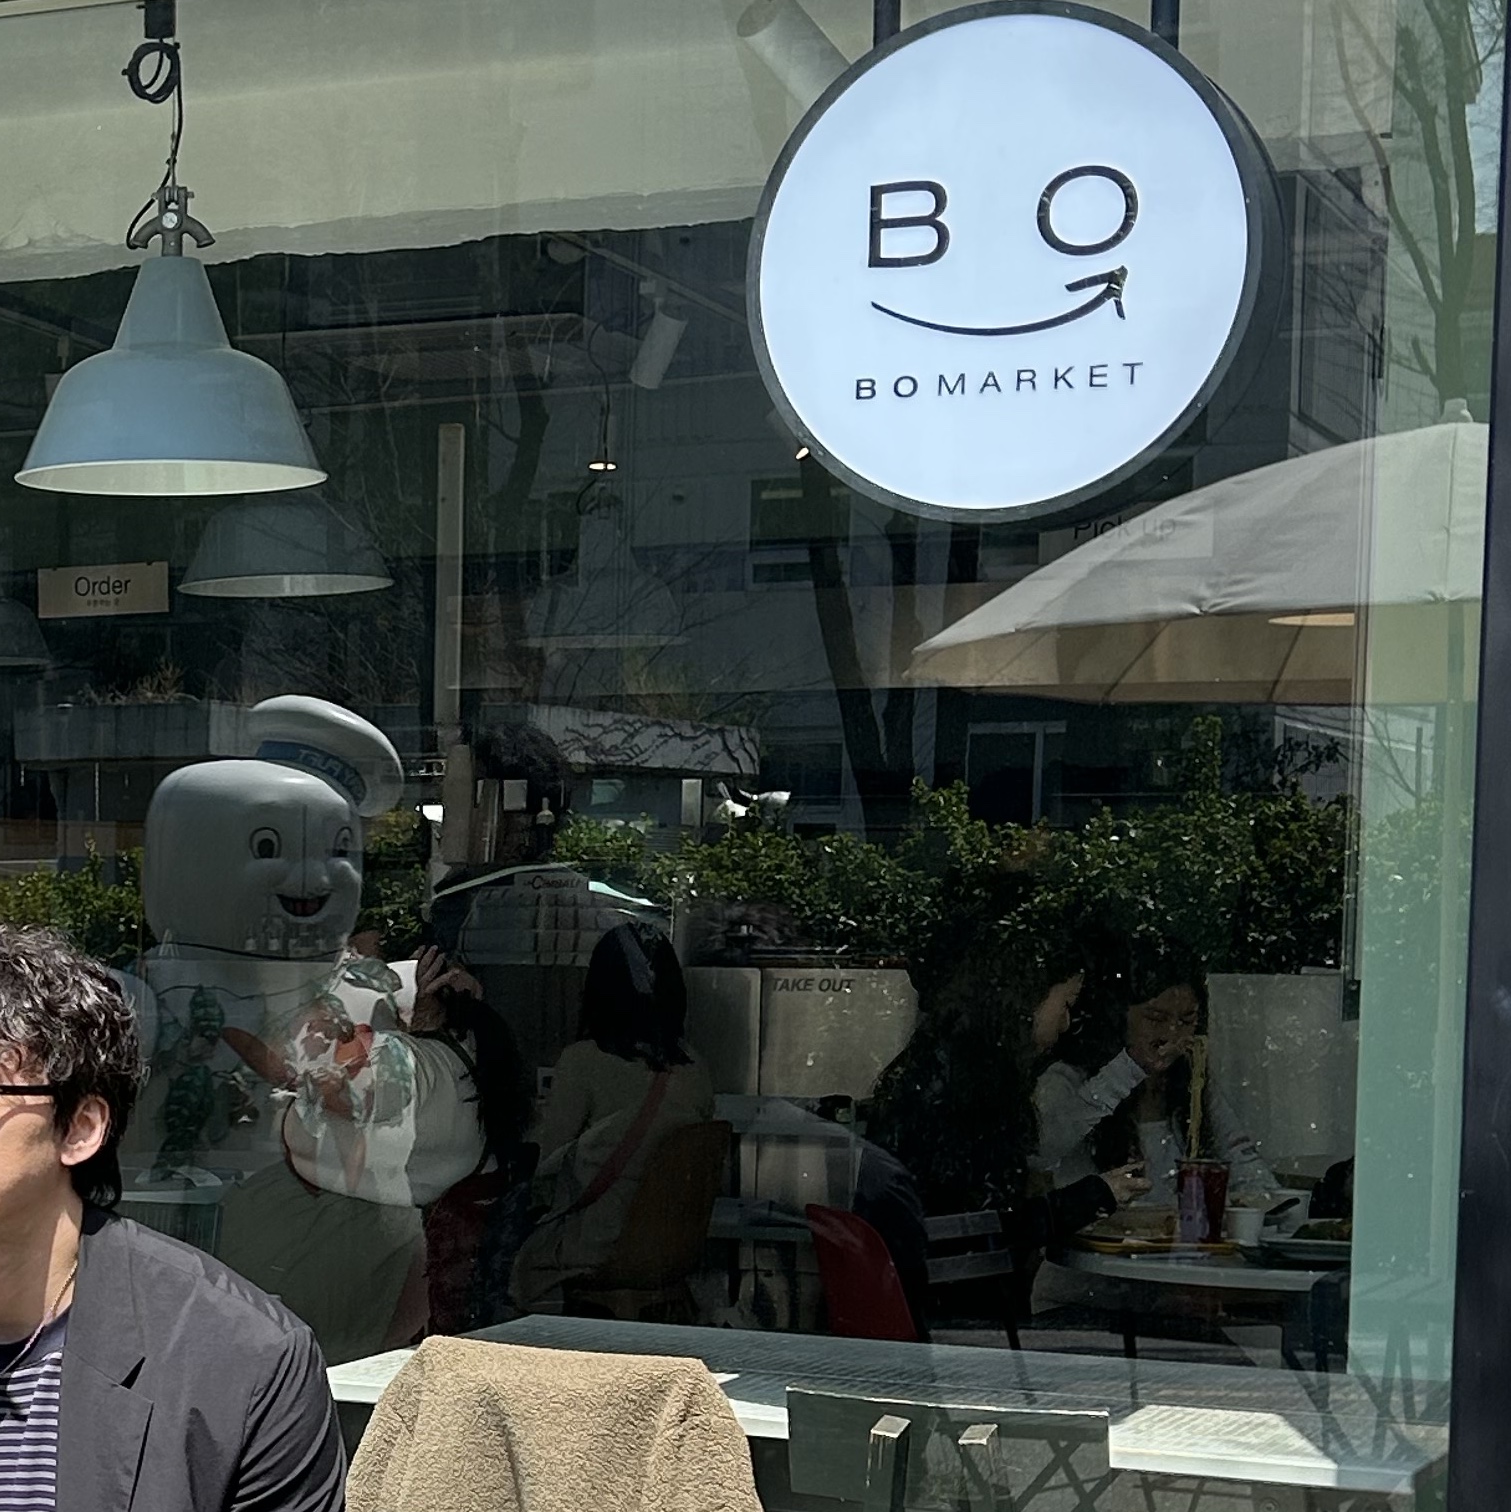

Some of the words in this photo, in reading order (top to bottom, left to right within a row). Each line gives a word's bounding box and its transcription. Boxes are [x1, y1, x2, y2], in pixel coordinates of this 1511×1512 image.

[74, 575, 131, 597] Order
[772, 977, 815, 992] TAKE
[818, 977, 856, 992] OUT
